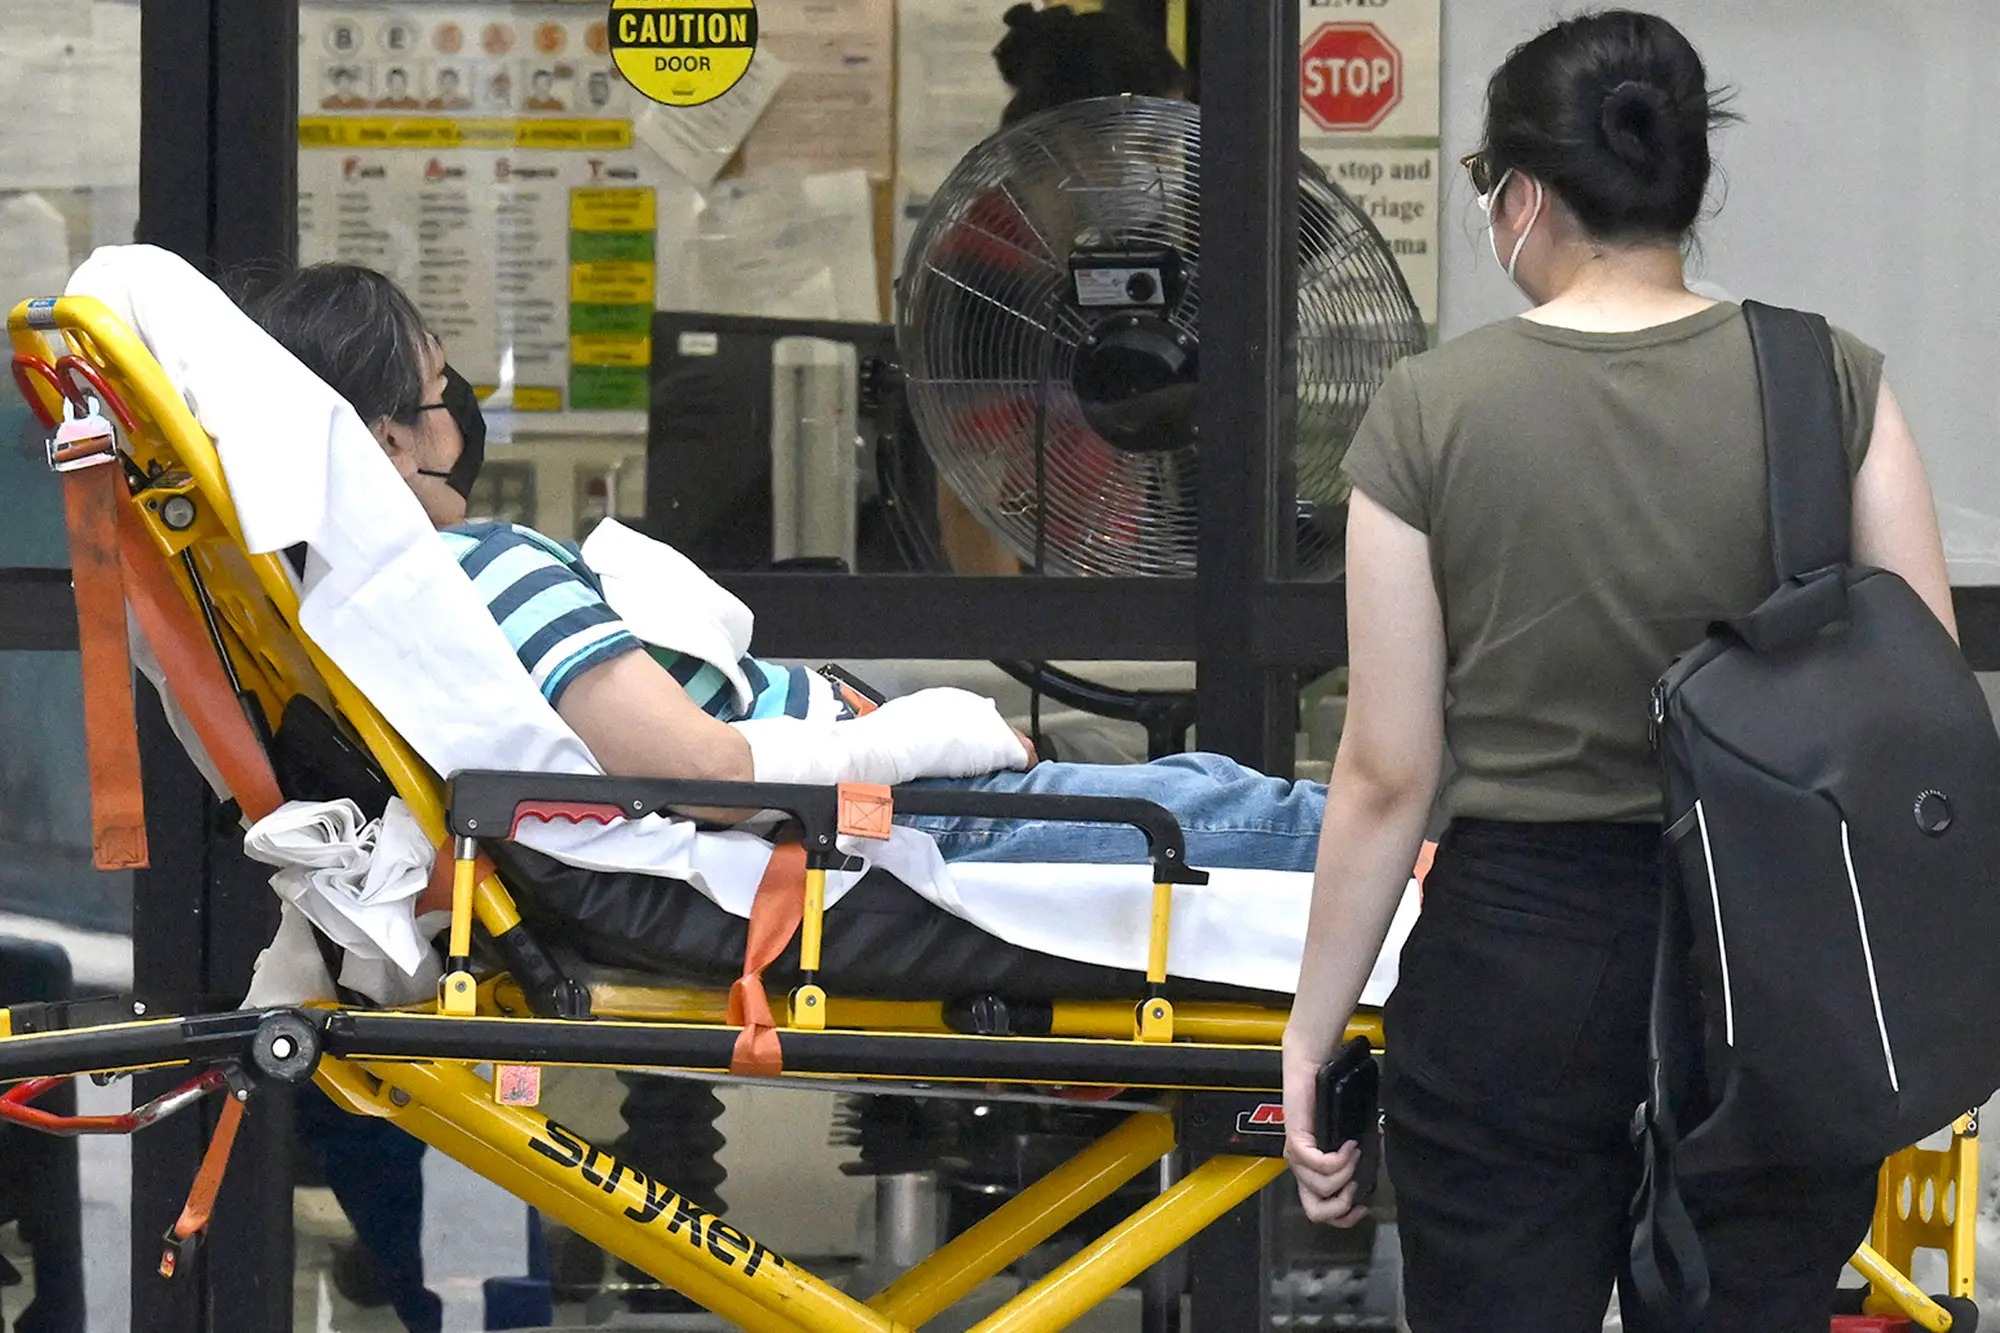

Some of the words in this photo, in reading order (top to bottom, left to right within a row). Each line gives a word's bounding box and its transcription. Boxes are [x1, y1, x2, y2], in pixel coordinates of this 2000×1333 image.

[618, 12, 748, 44] CAUTION
[654, 55, 711, 72] DOOR
[1304, 57, 1392, 97] STOP
[1338, 160, 1383, 185] stop
[1390, 158, 1431, 181] and
